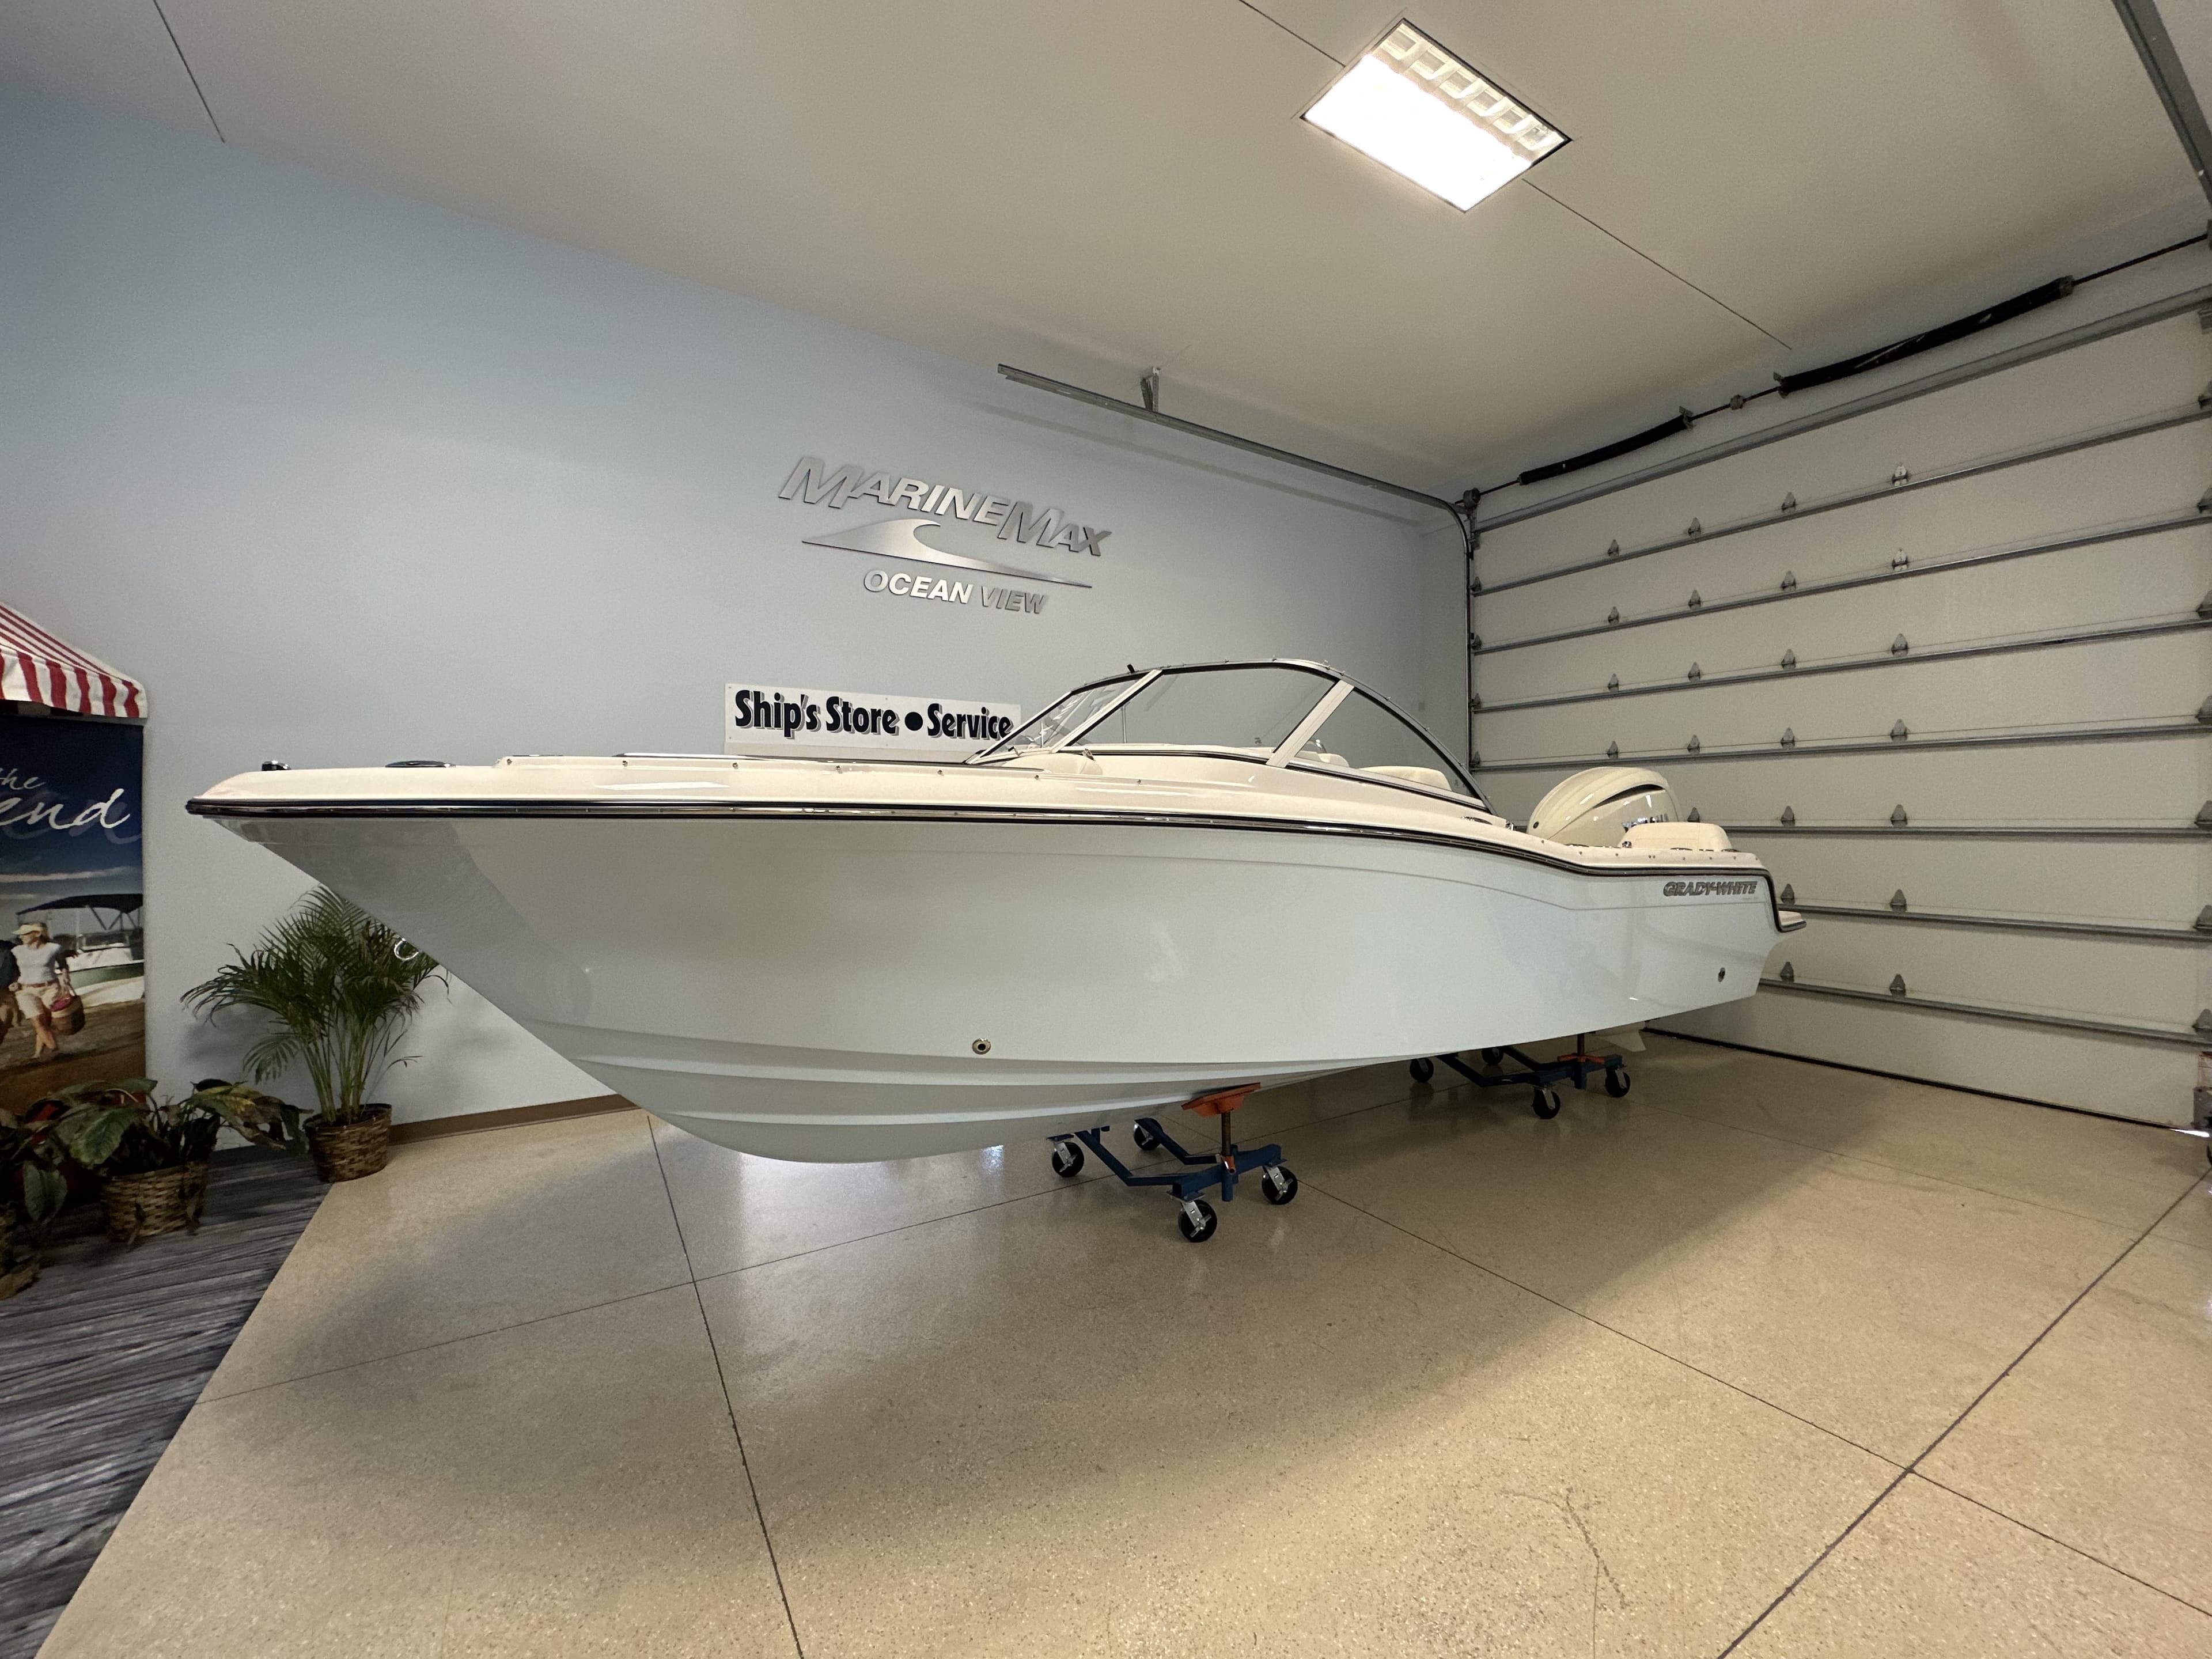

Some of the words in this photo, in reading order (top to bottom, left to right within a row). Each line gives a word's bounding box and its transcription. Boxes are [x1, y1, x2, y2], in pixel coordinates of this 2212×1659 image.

[864, 570, 974, 604] OCEAN
[982, 585, 1048, 614] VIEW
[734, 690, 819, 740] Ship's
[825, 696, 900, 736] Store
[927, 703, 1014, 741] Service
[1663, 881, 1758, 897] GRADY-WHITE
